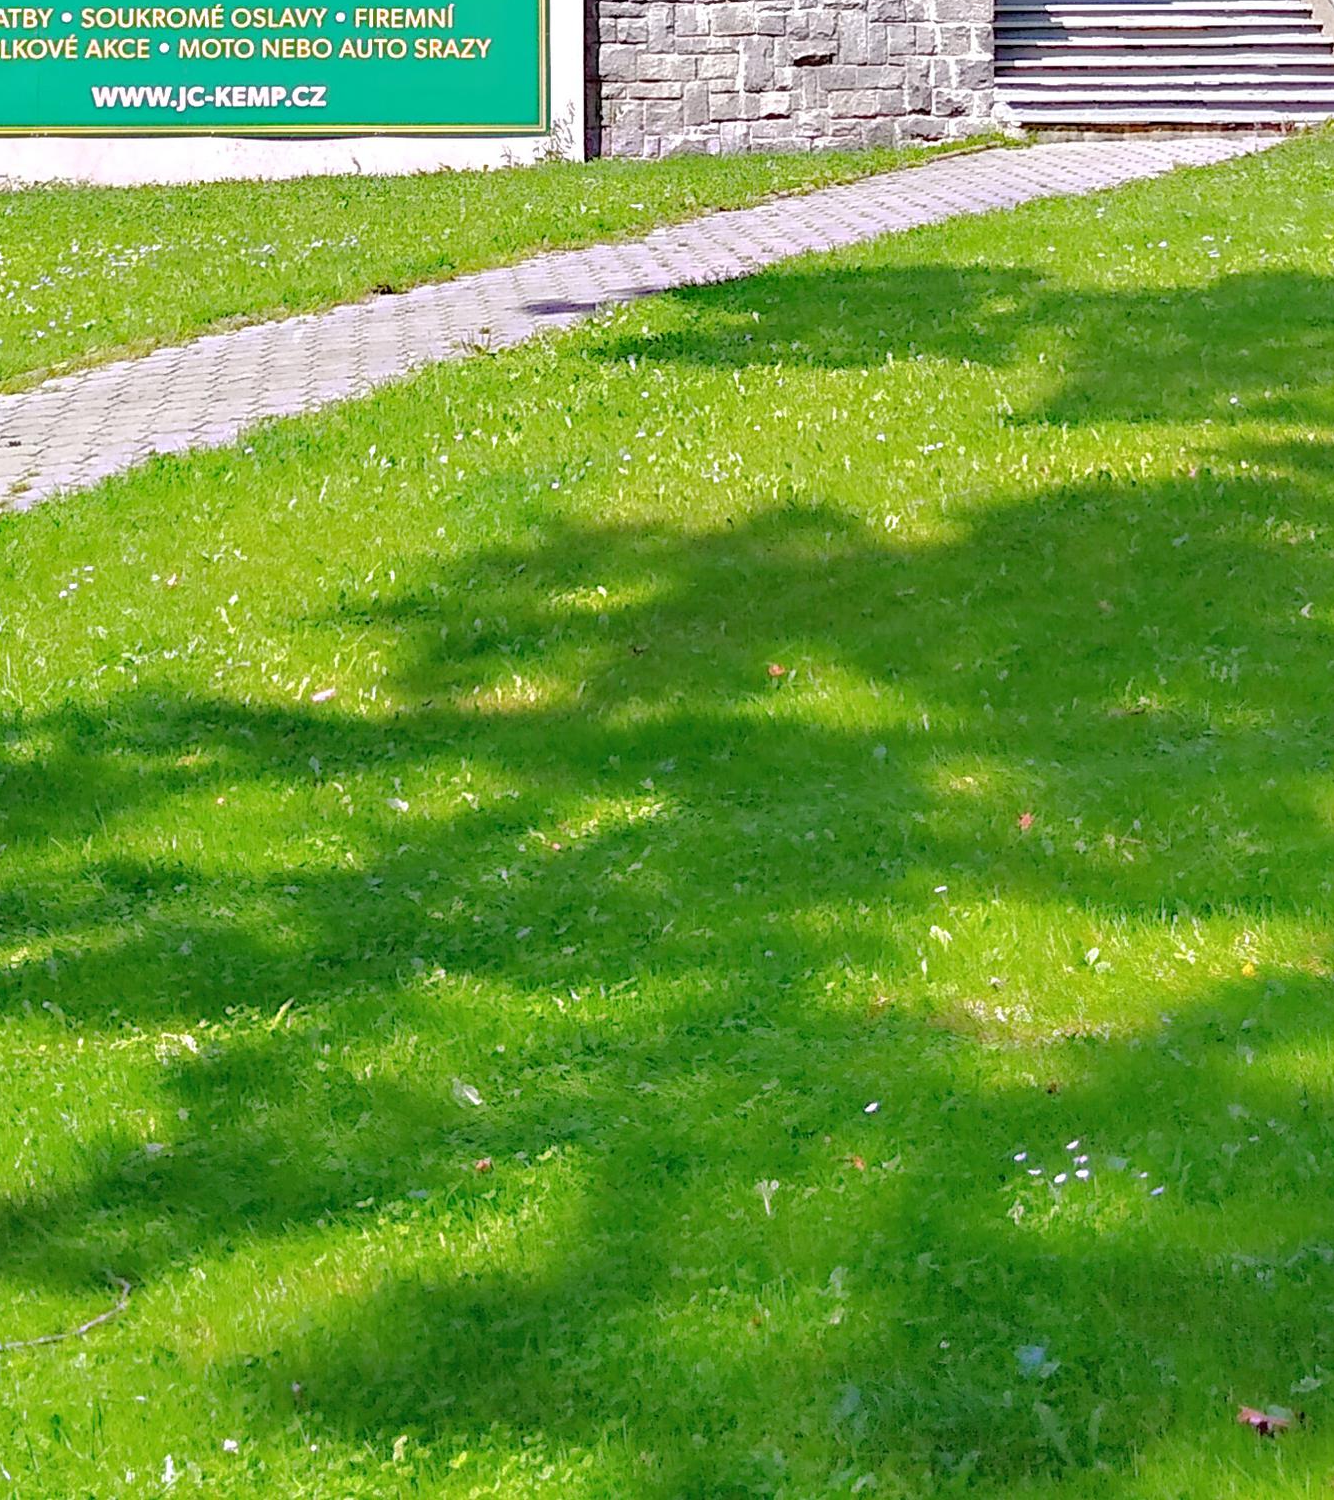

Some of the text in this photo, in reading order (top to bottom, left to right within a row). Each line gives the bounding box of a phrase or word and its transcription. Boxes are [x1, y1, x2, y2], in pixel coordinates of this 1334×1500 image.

[81, 4, 224, 29] SOUKROMÉ
[231, 7, 328, 29] OSLAVY
[354, 3, 455, 29] FIREMNÍ
[84, 38, 150, 59] AKCE
[178, 38, 255, 59] MOTO
[262, 38, 333, 59] NEBO
[338, 38, 407, 59] AUTO
[414, 38, 492, 59] SRAZY
[91, 86, 327, 112] WWW.JC-KEMP.CZ
